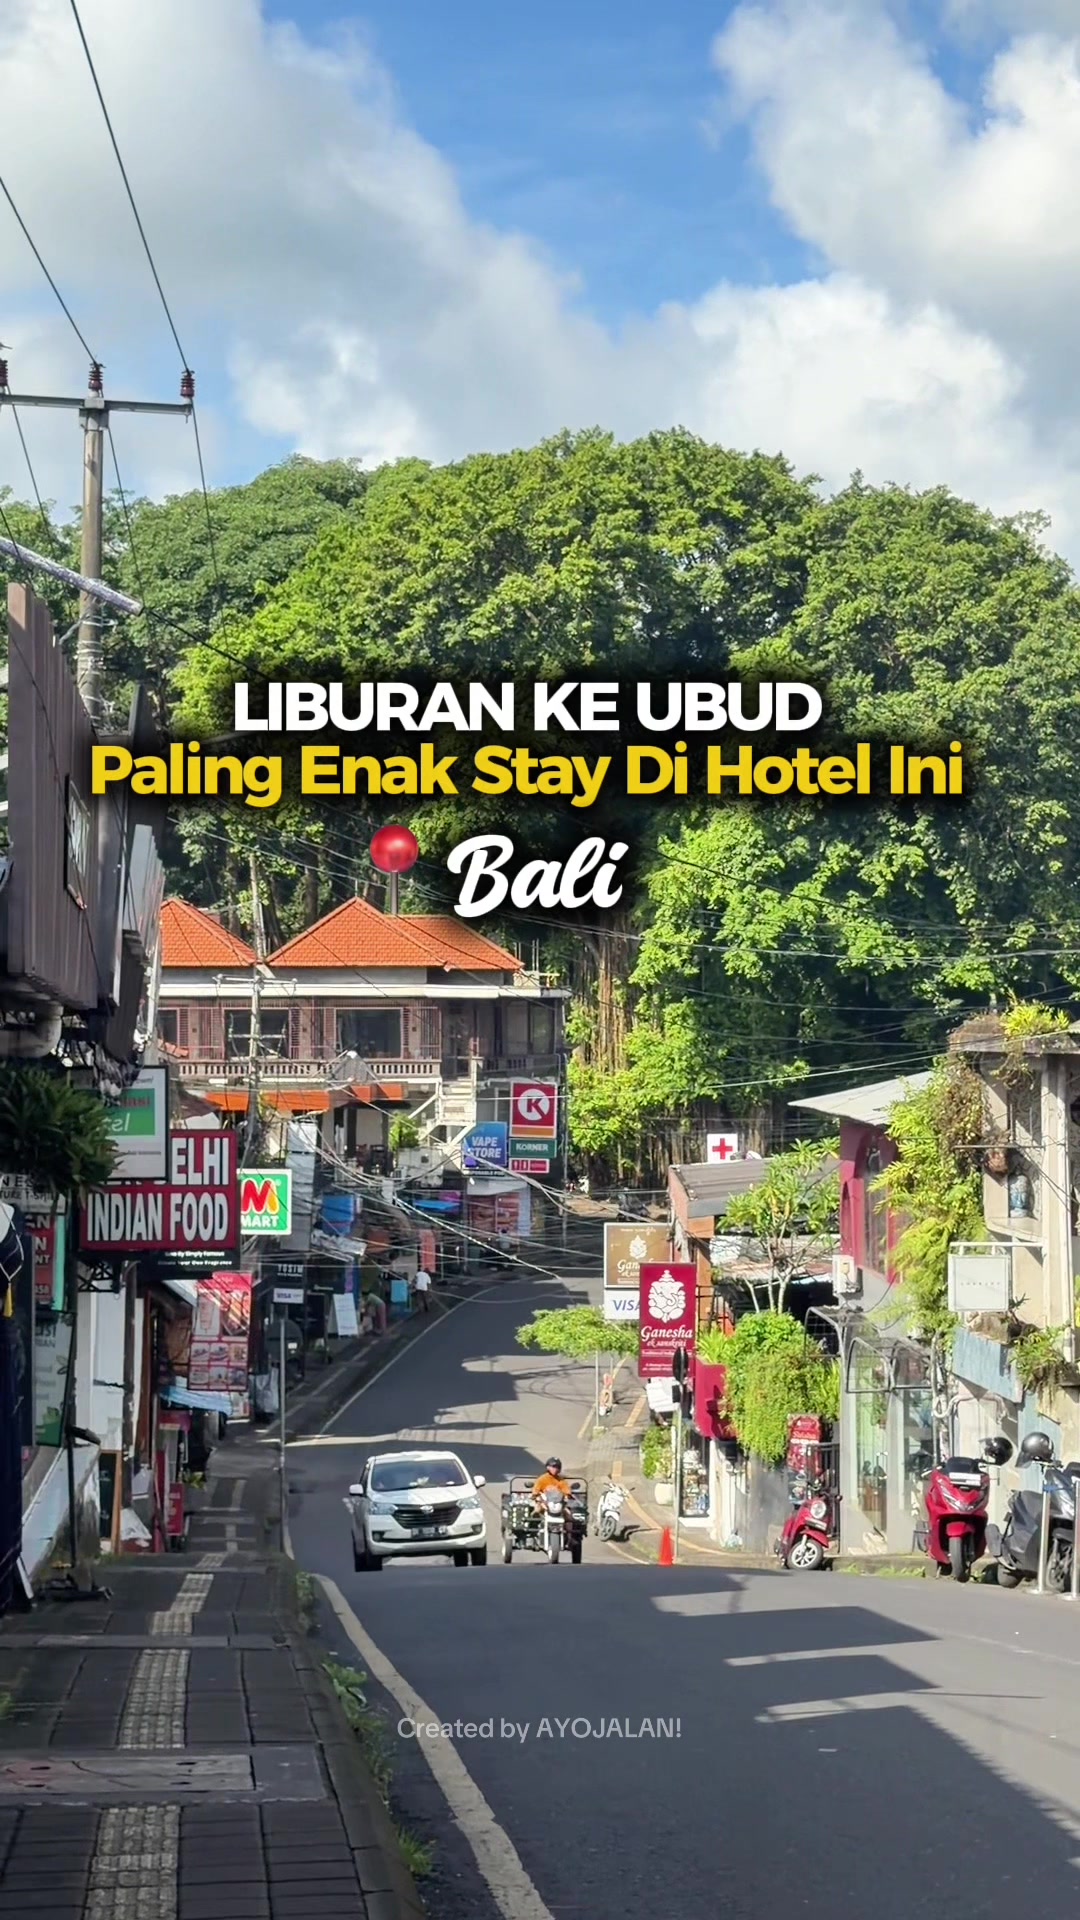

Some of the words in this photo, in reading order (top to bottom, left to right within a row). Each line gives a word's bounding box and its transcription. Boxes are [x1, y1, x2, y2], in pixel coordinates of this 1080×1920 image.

[471, 1136, 498, 1147] VAPE
[515, 1143, 549, 1152] KORNER
[156, 1137, 229, 1185] ELHI
[87, 1192, 163, 1242] INDIAN
[169, 1191, 229, 1242] FOOD
[240, 1214, 279, 1228] MART
[640, 1324, 693, 1342] Ganesha
